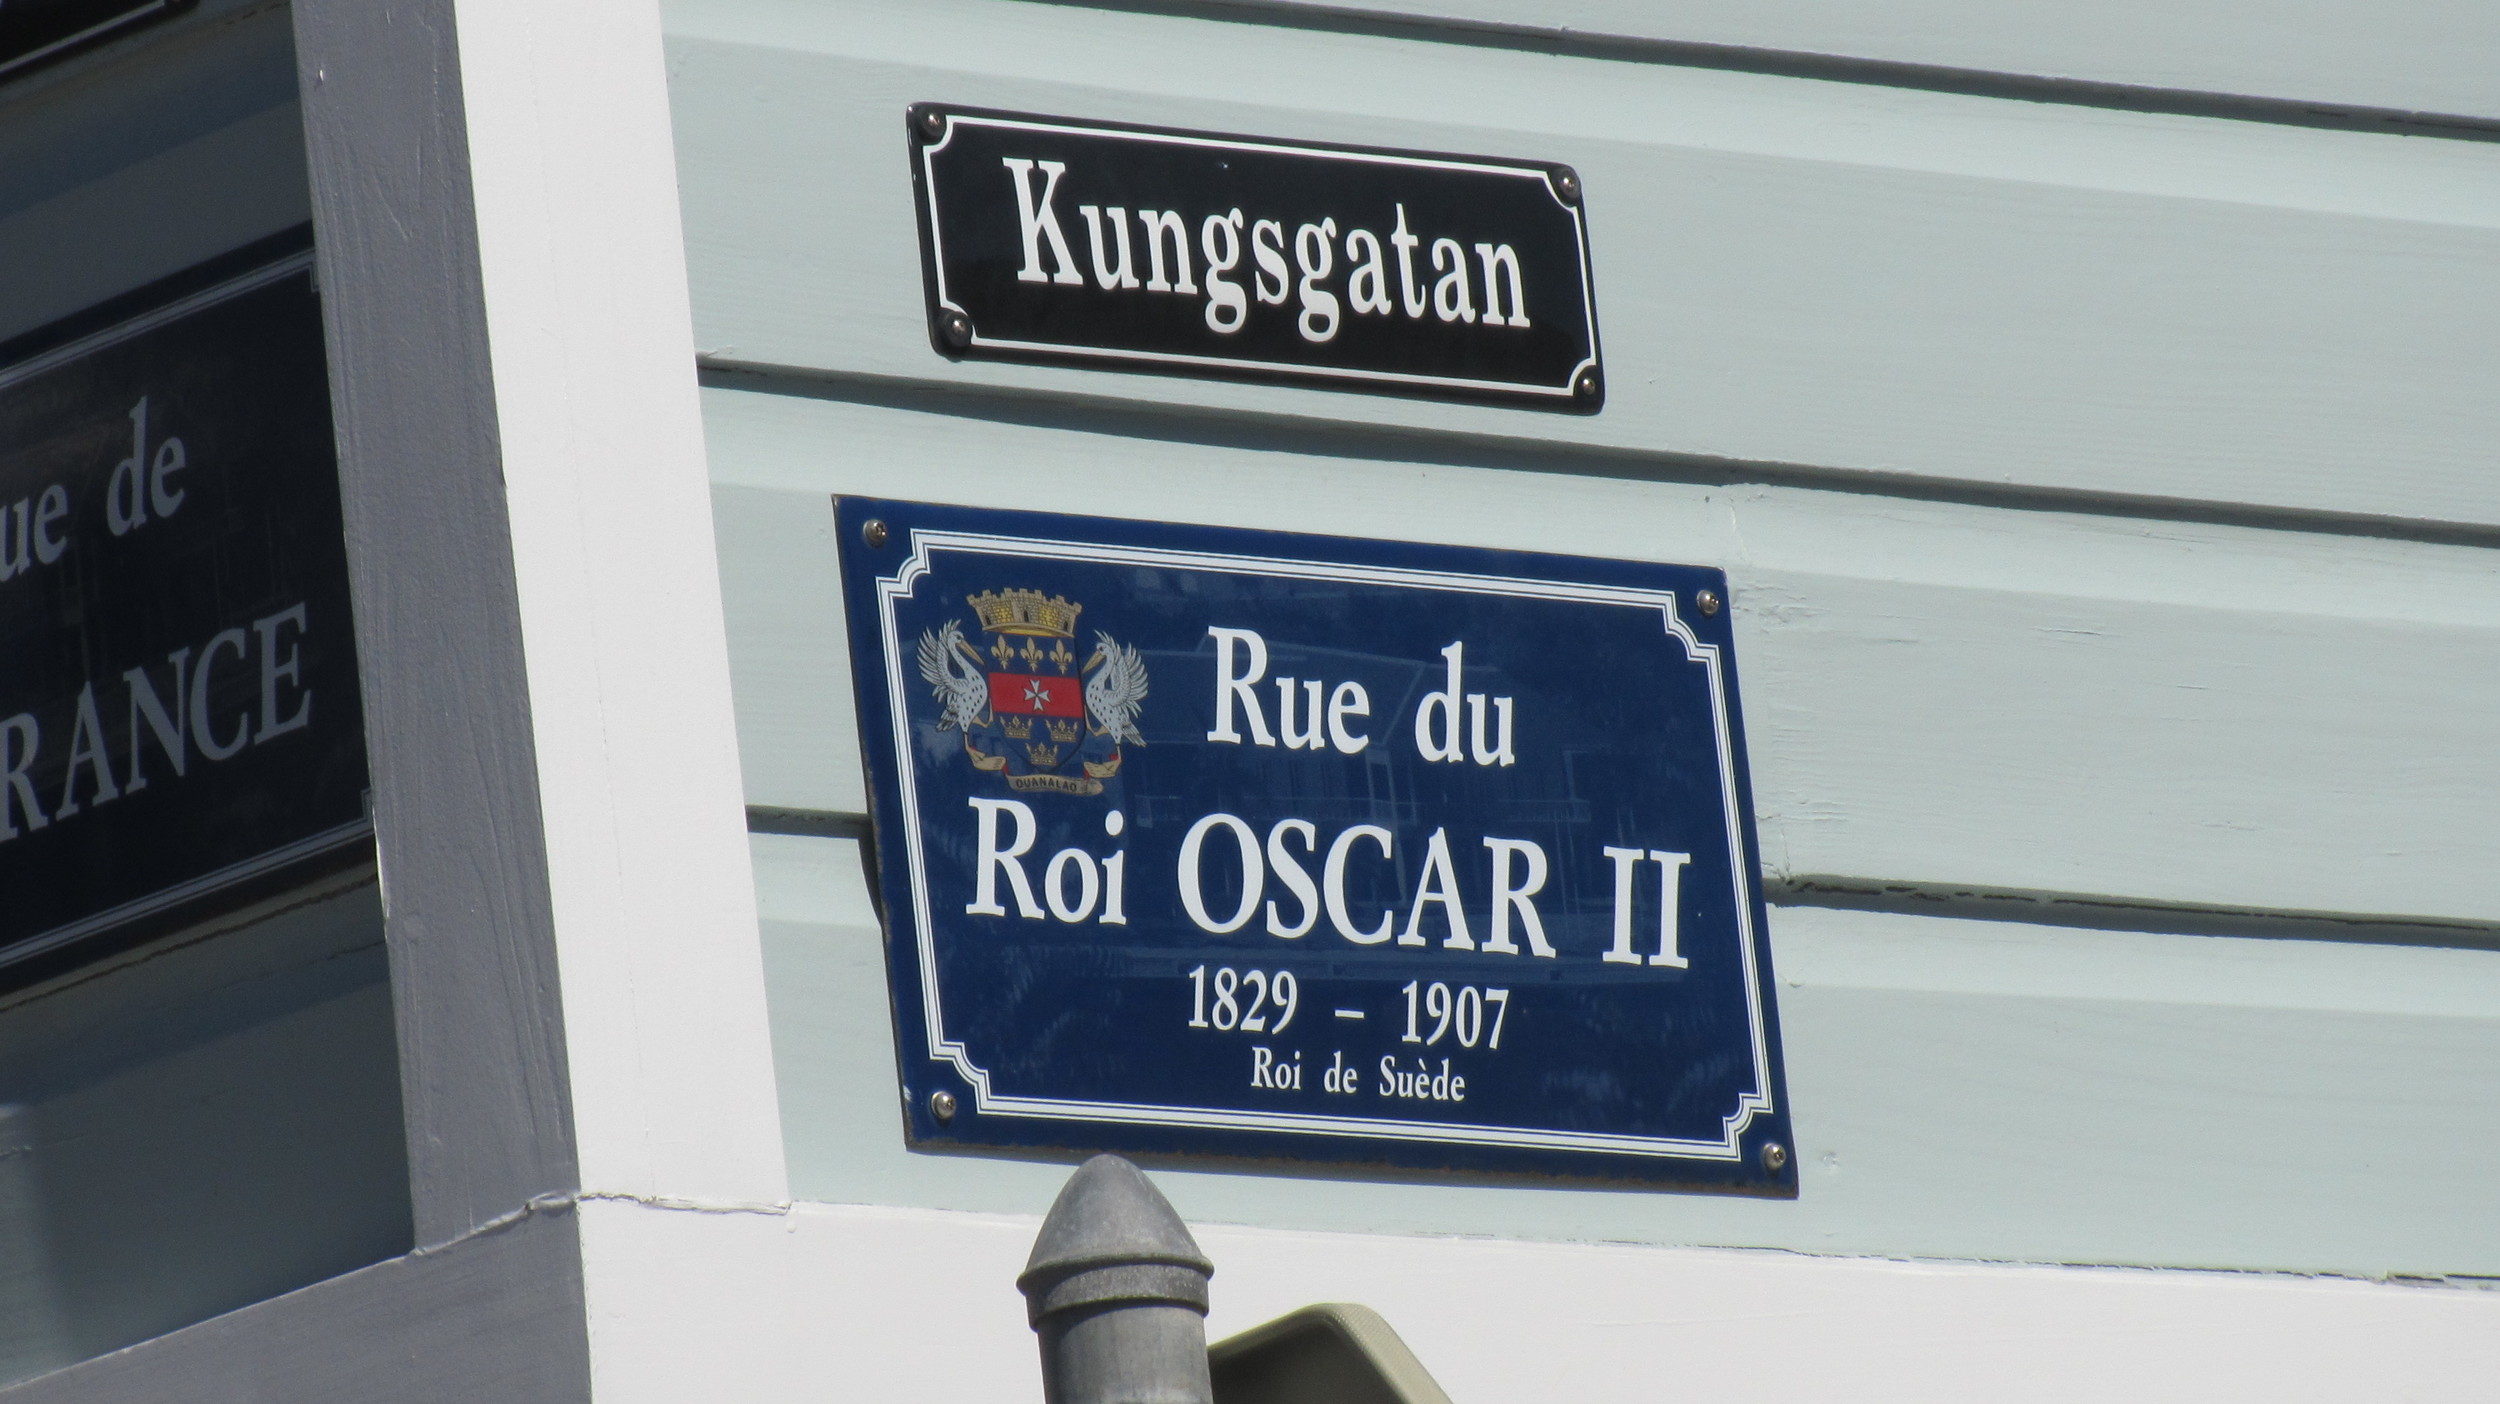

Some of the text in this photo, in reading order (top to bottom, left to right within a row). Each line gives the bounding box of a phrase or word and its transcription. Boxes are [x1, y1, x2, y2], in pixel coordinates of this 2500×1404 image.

[1002, 157, 1531, 343] Kungsgatan
[107, 396, 187, 537] de
[0, 602, 312, 842] RANCE
[1206, 625, 1516, 769] Rue du
[1015, 776, 1077, 792] OUANALAO
[965, 796, 1691, 970] Roi OSCAR II
[1188, 964, 1299, 1035] 1829
[1401, 980, 1510, 1050] 1907
[1250, 1046, 1466, 1103] Roi de Suède
